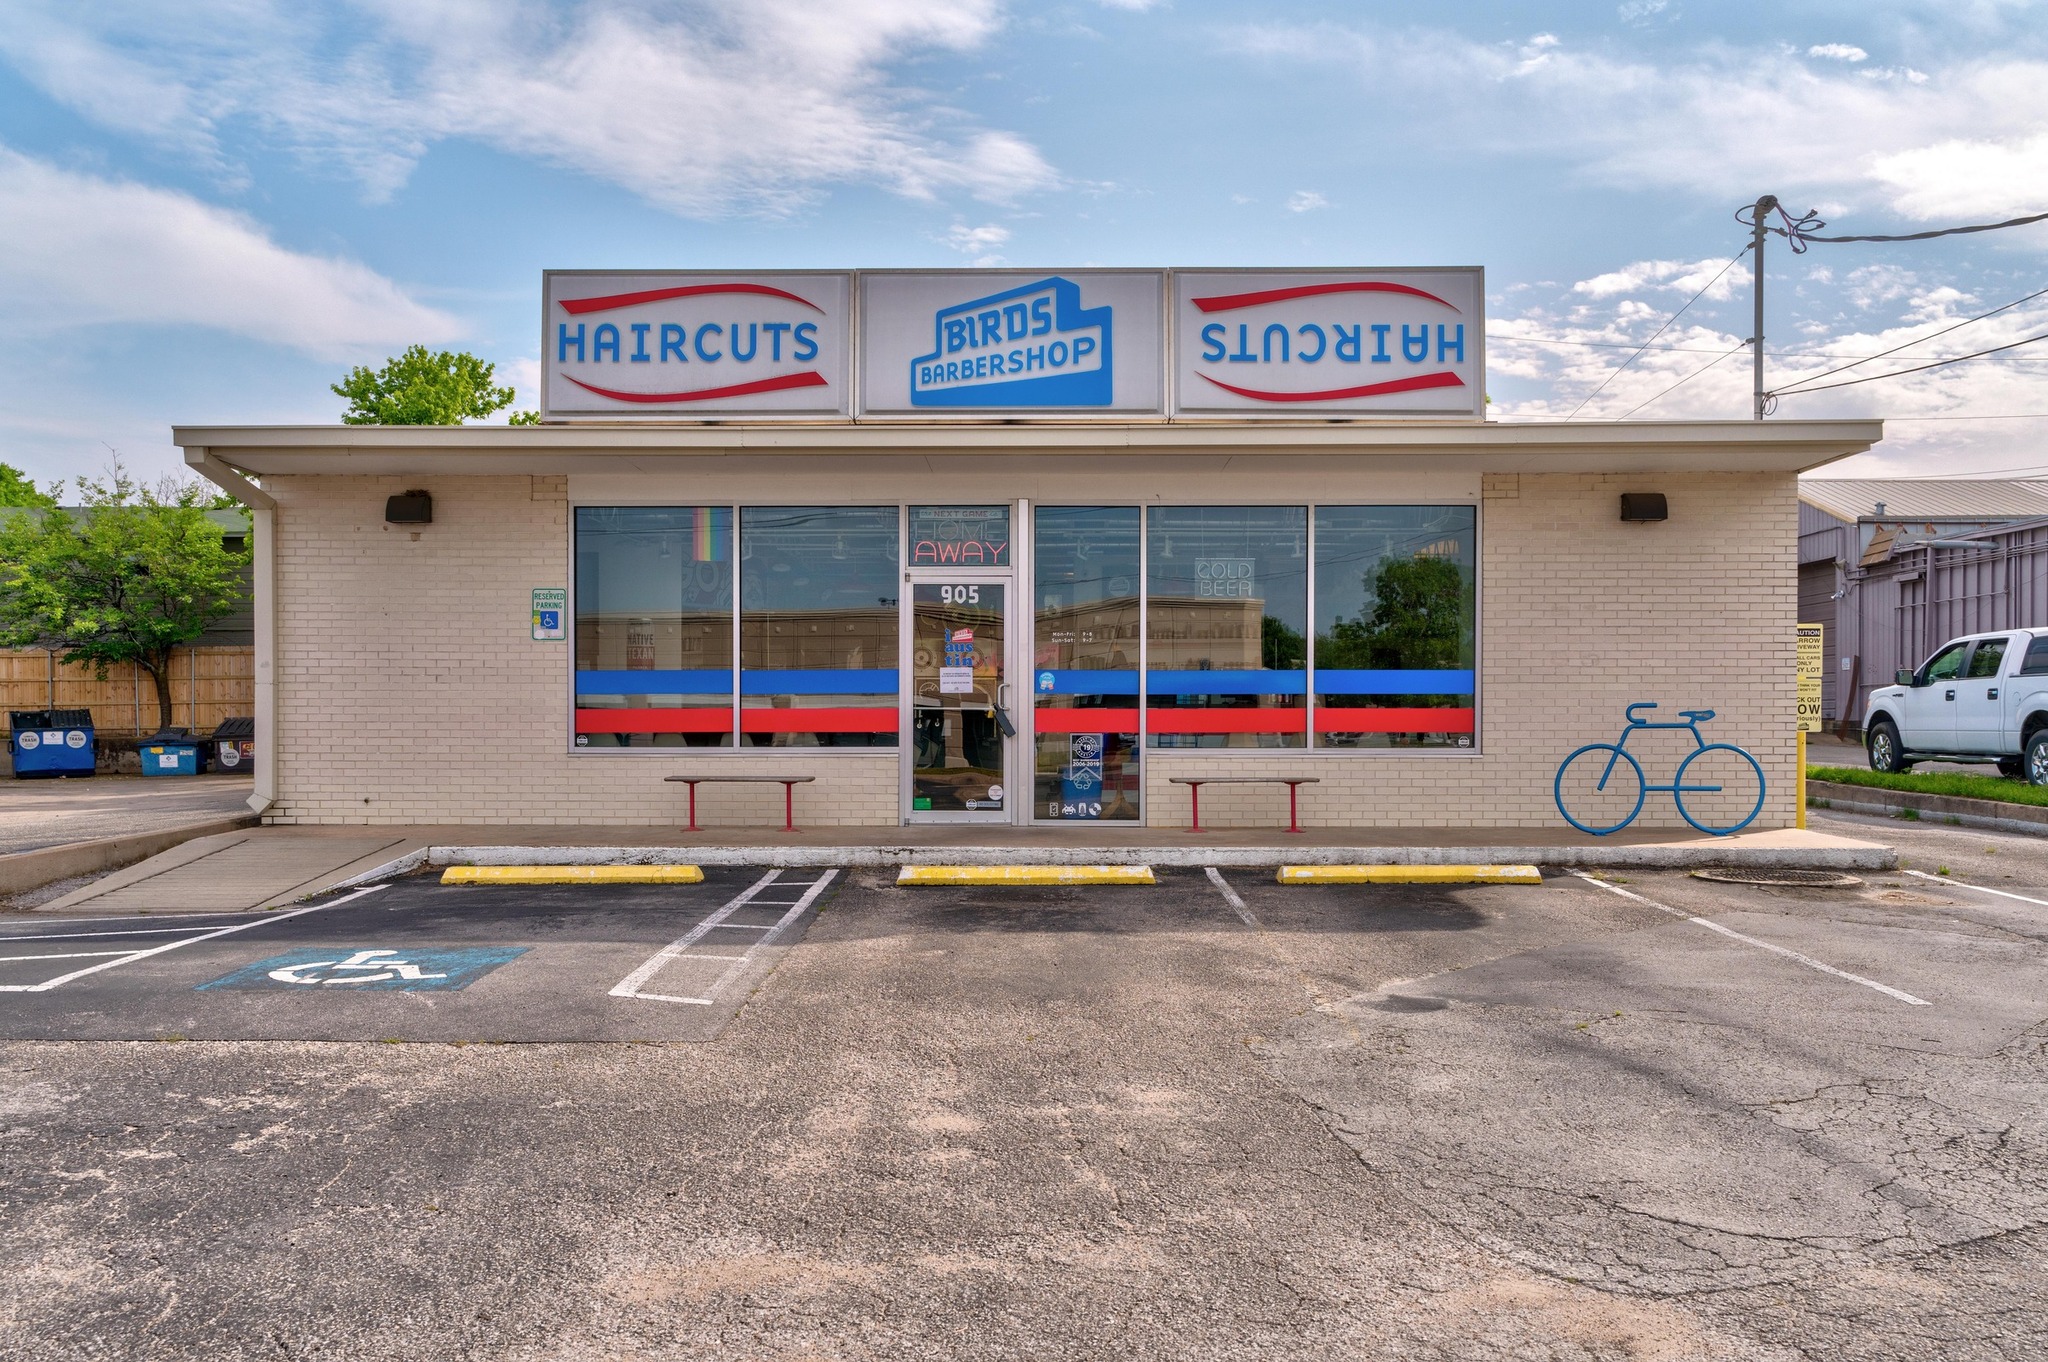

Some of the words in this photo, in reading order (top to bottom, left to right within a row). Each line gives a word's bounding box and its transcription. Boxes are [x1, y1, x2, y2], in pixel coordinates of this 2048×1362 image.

[944, 296, 1052, 354] BIRDS
[558, 323, 819, 363] HAIRCUTS
[1202, 322, 1464, 363] HAIRCUTS
[921, 336, 1096, 385] BARBERSHOP
[914, 541, 1007, 564] AWAY
[1198, 562, 1251, 579] COLD
[941, 585, 979, 604] 905
[1200, 580, 1252, 596] BEER
[627, 634, 654, 646] NATIVE
[944, 643, 974, 652] aus
[628, 647, 654, 660] TEXAN
[944, 654, 973, 666] tin
